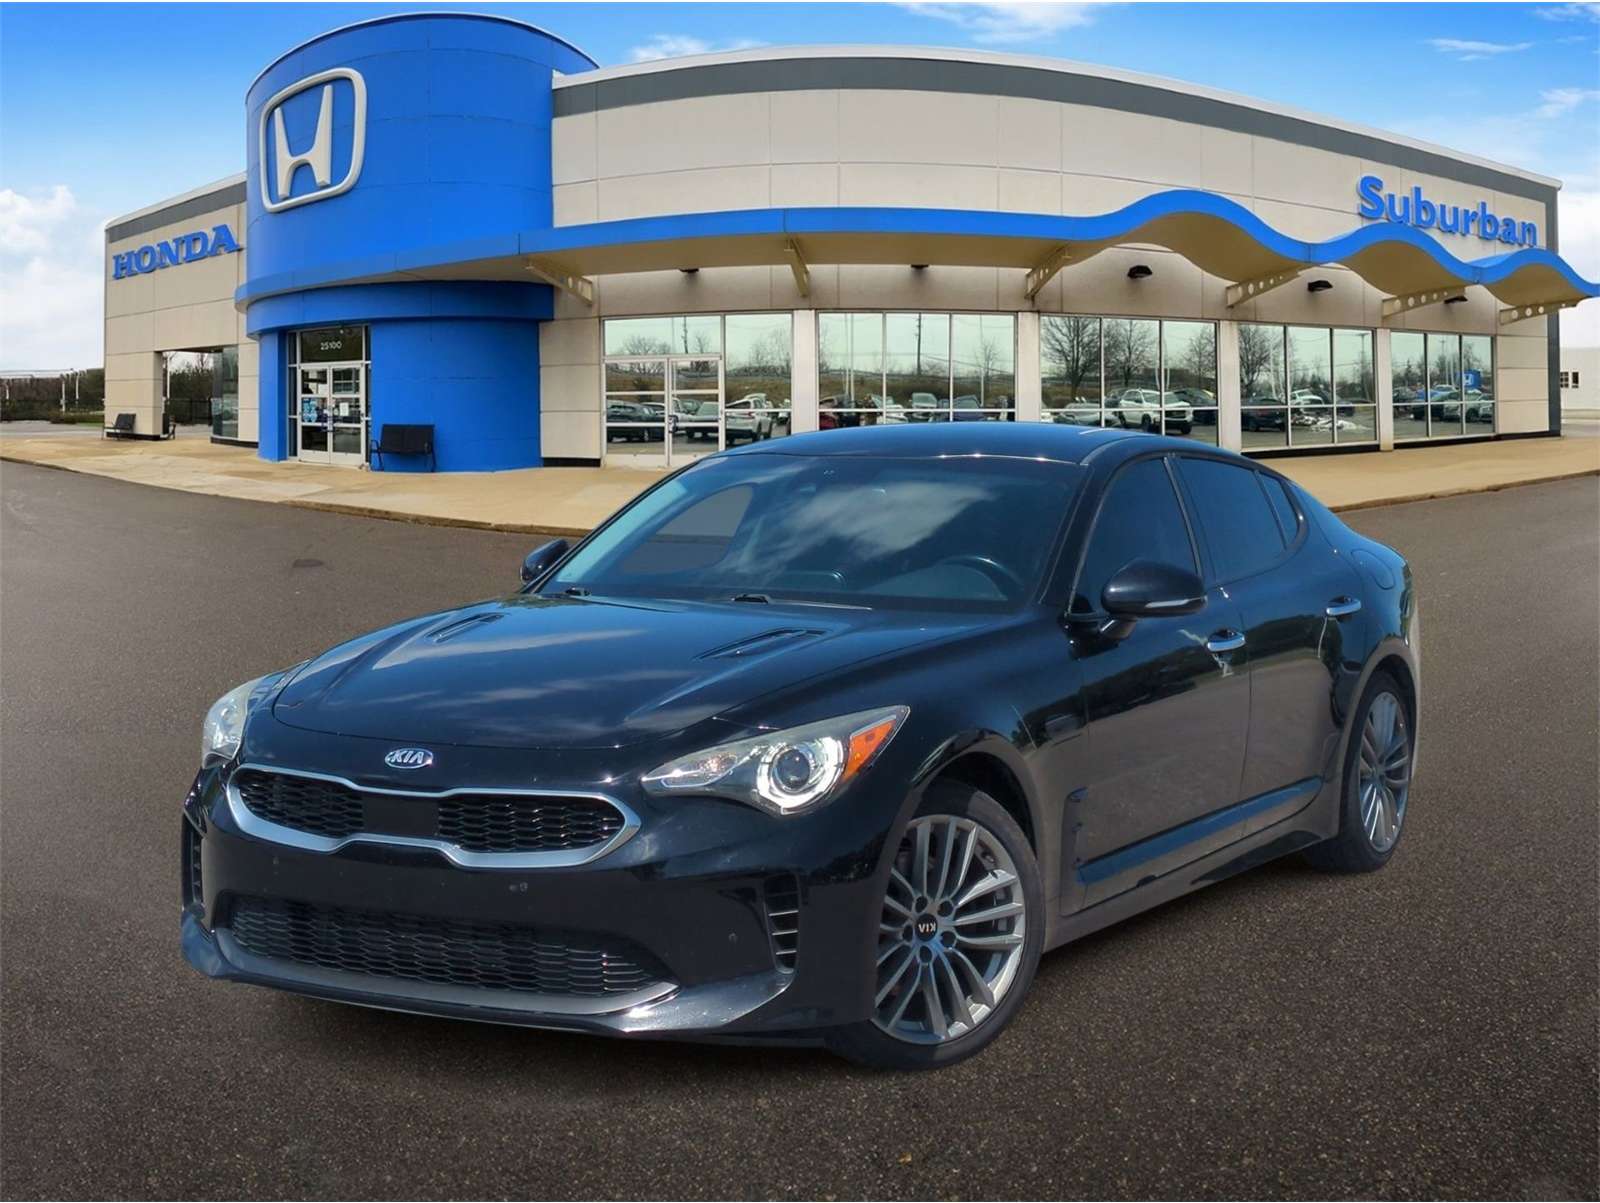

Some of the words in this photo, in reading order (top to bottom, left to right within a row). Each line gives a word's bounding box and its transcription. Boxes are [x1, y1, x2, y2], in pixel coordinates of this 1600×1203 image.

[1358, 175, 1537, 246] Suburban
[112, 224, 240, 280] HONDA
[390, 750, 424, 764] KIA
